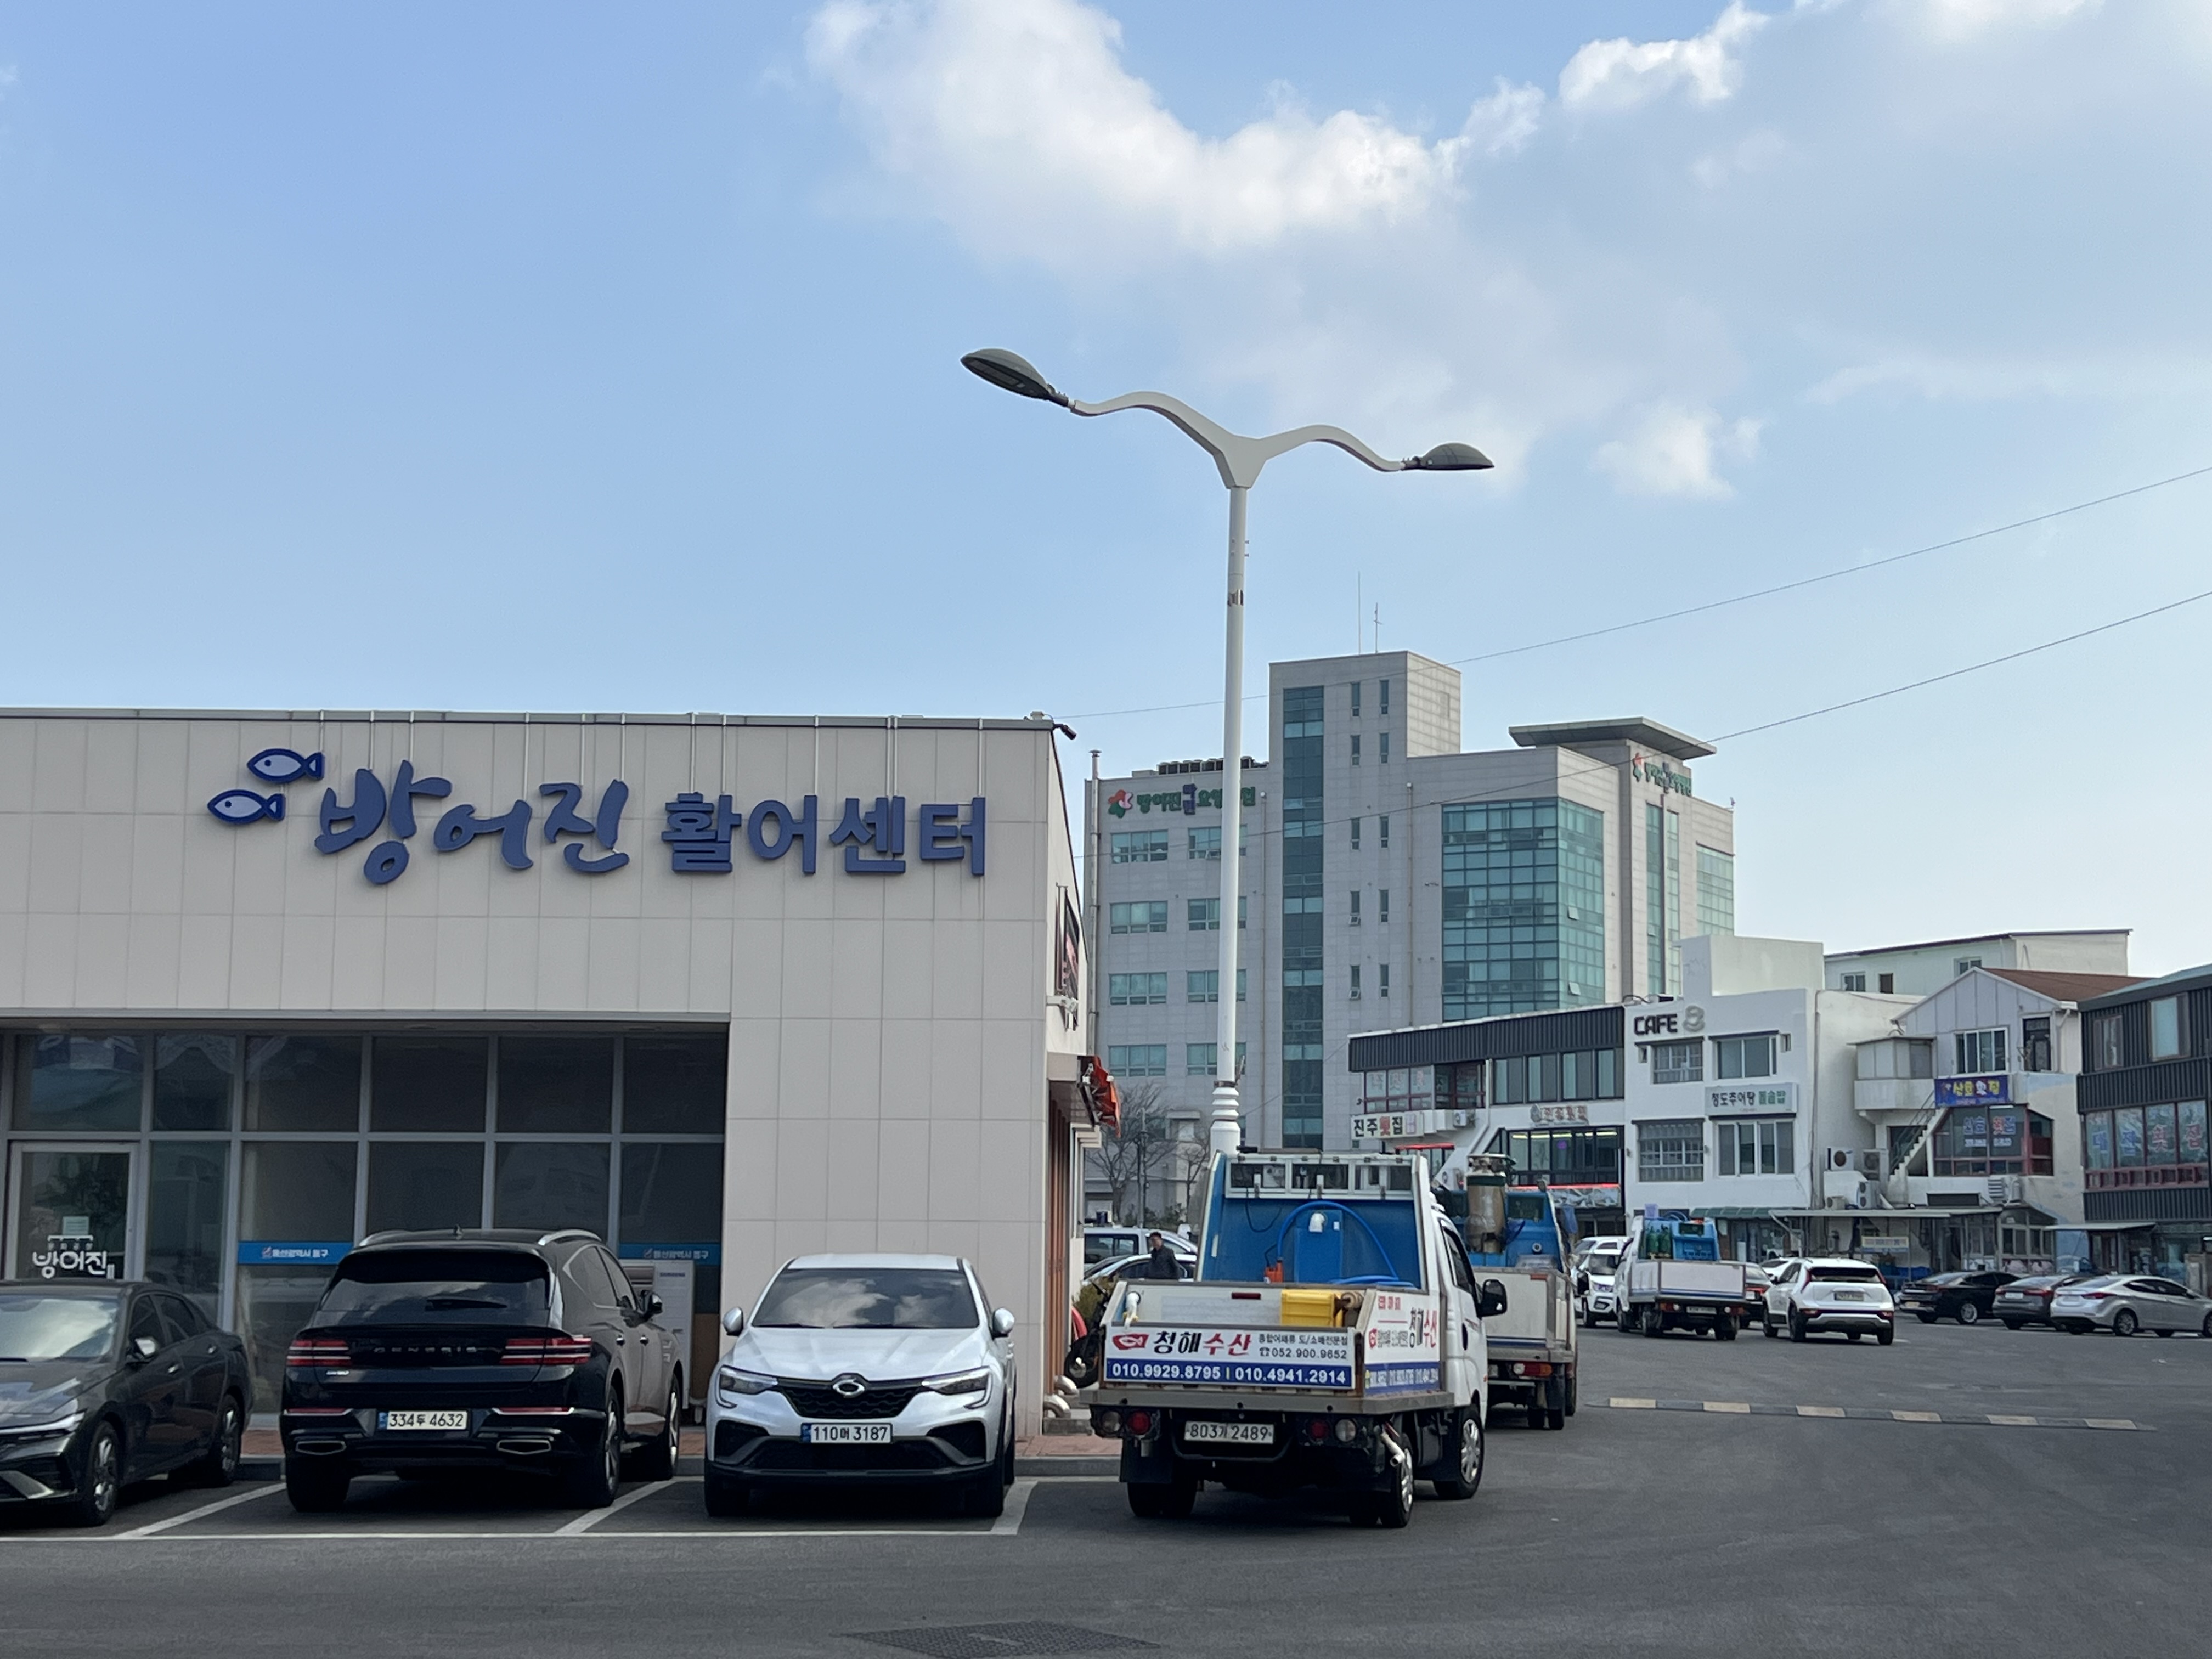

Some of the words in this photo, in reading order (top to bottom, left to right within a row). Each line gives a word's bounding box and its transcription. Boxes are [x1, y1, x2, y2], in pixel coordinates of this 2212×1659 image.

[314, 759, 630, 884] 방어진
[661, 792, 986, 876] 활어센터
[1634, 1013, 1678, 1035] CAFE
[1354, 1116, 1403, 1137] 진주횟집
[32, 1251, 107, 1279] 방어진
[1154, 1331, 1252, 1356] 청해수산
[1113, 1363, 1221, 1379] 010.9929.8795
[1235, 1367, 1346, 1383] 010.4941.2914
[430, 1413, 463, 1426] 4632
[853, 1426, 888, 1440] 3187
[1231, 1425, 1268, 1440] 2489
